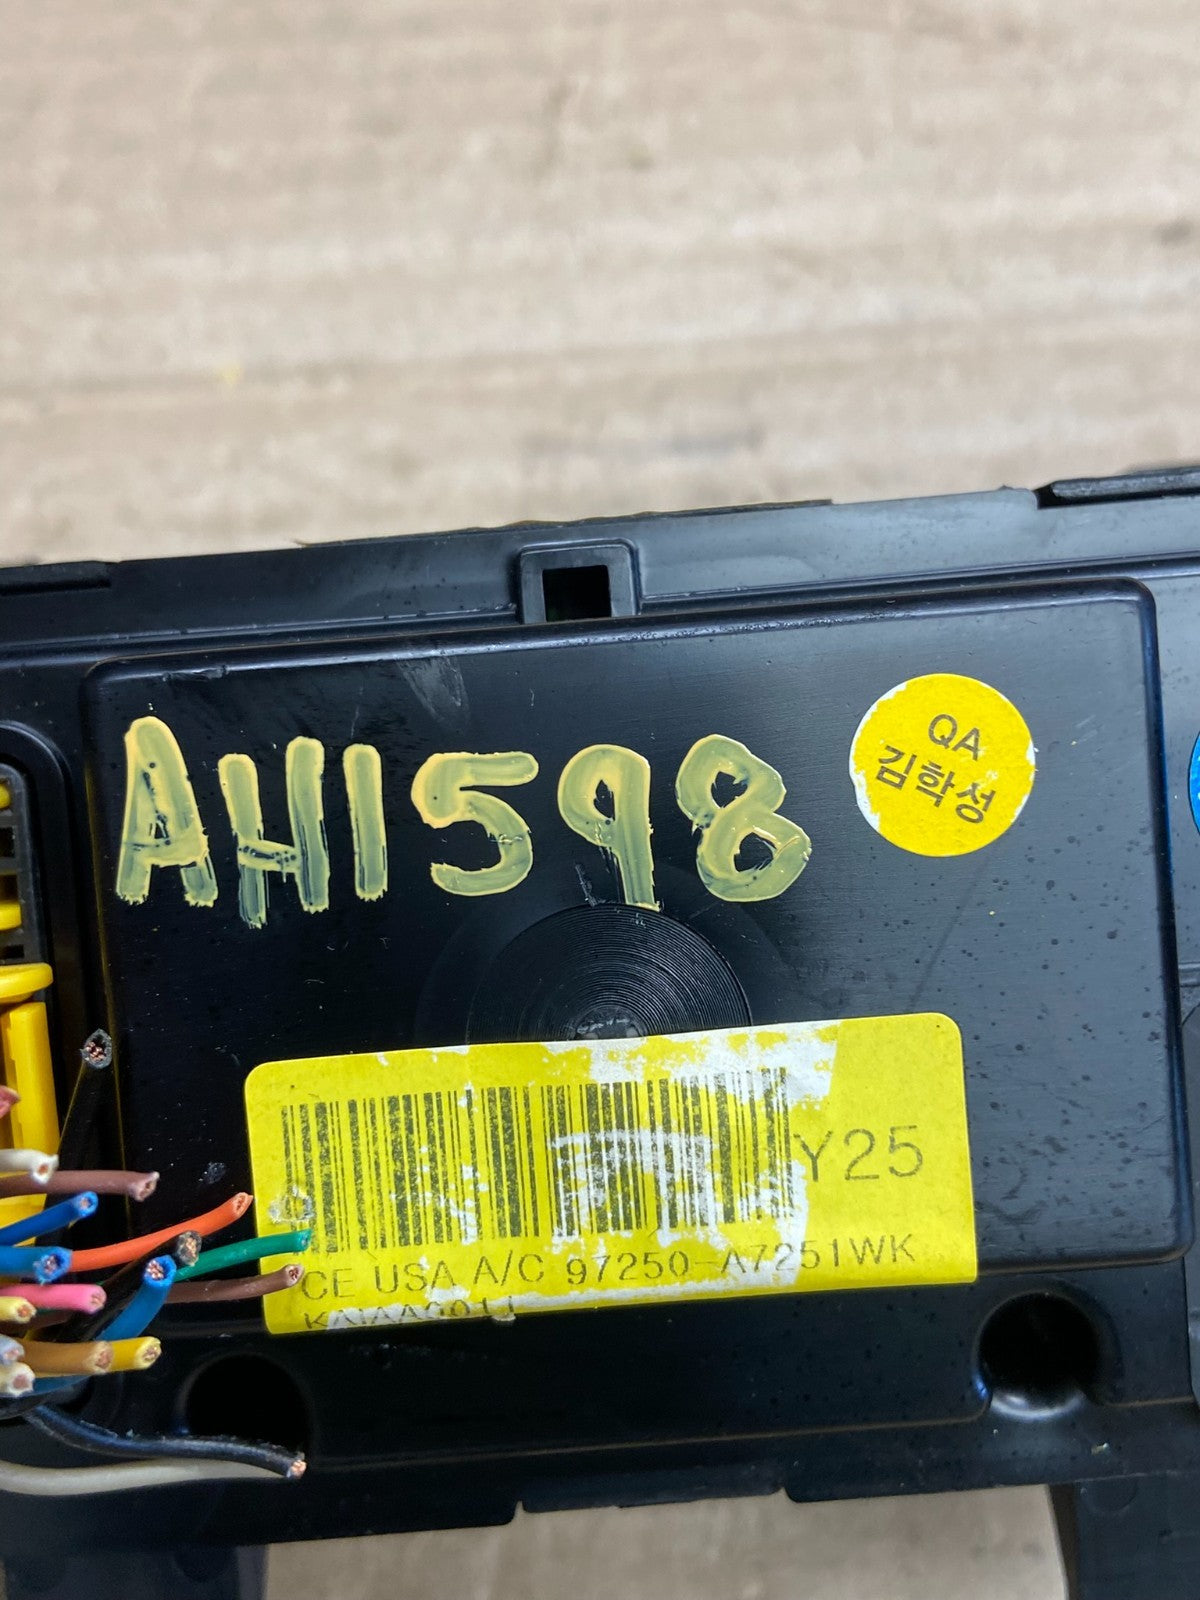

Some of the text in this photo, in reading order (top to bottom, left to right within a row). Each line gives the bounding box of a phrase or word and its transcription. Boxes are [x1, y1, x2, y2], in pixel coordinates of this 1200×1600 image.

[928, 714, 980, 761] QA
[876, 745, 996, 824] 김학성
[792, 1124, 924, 1182] Y25
[301, 1268, 355, 1300] CE
[375, 1260, 458, 1294] USA
[473, 1250, 545, 1286] A/C
